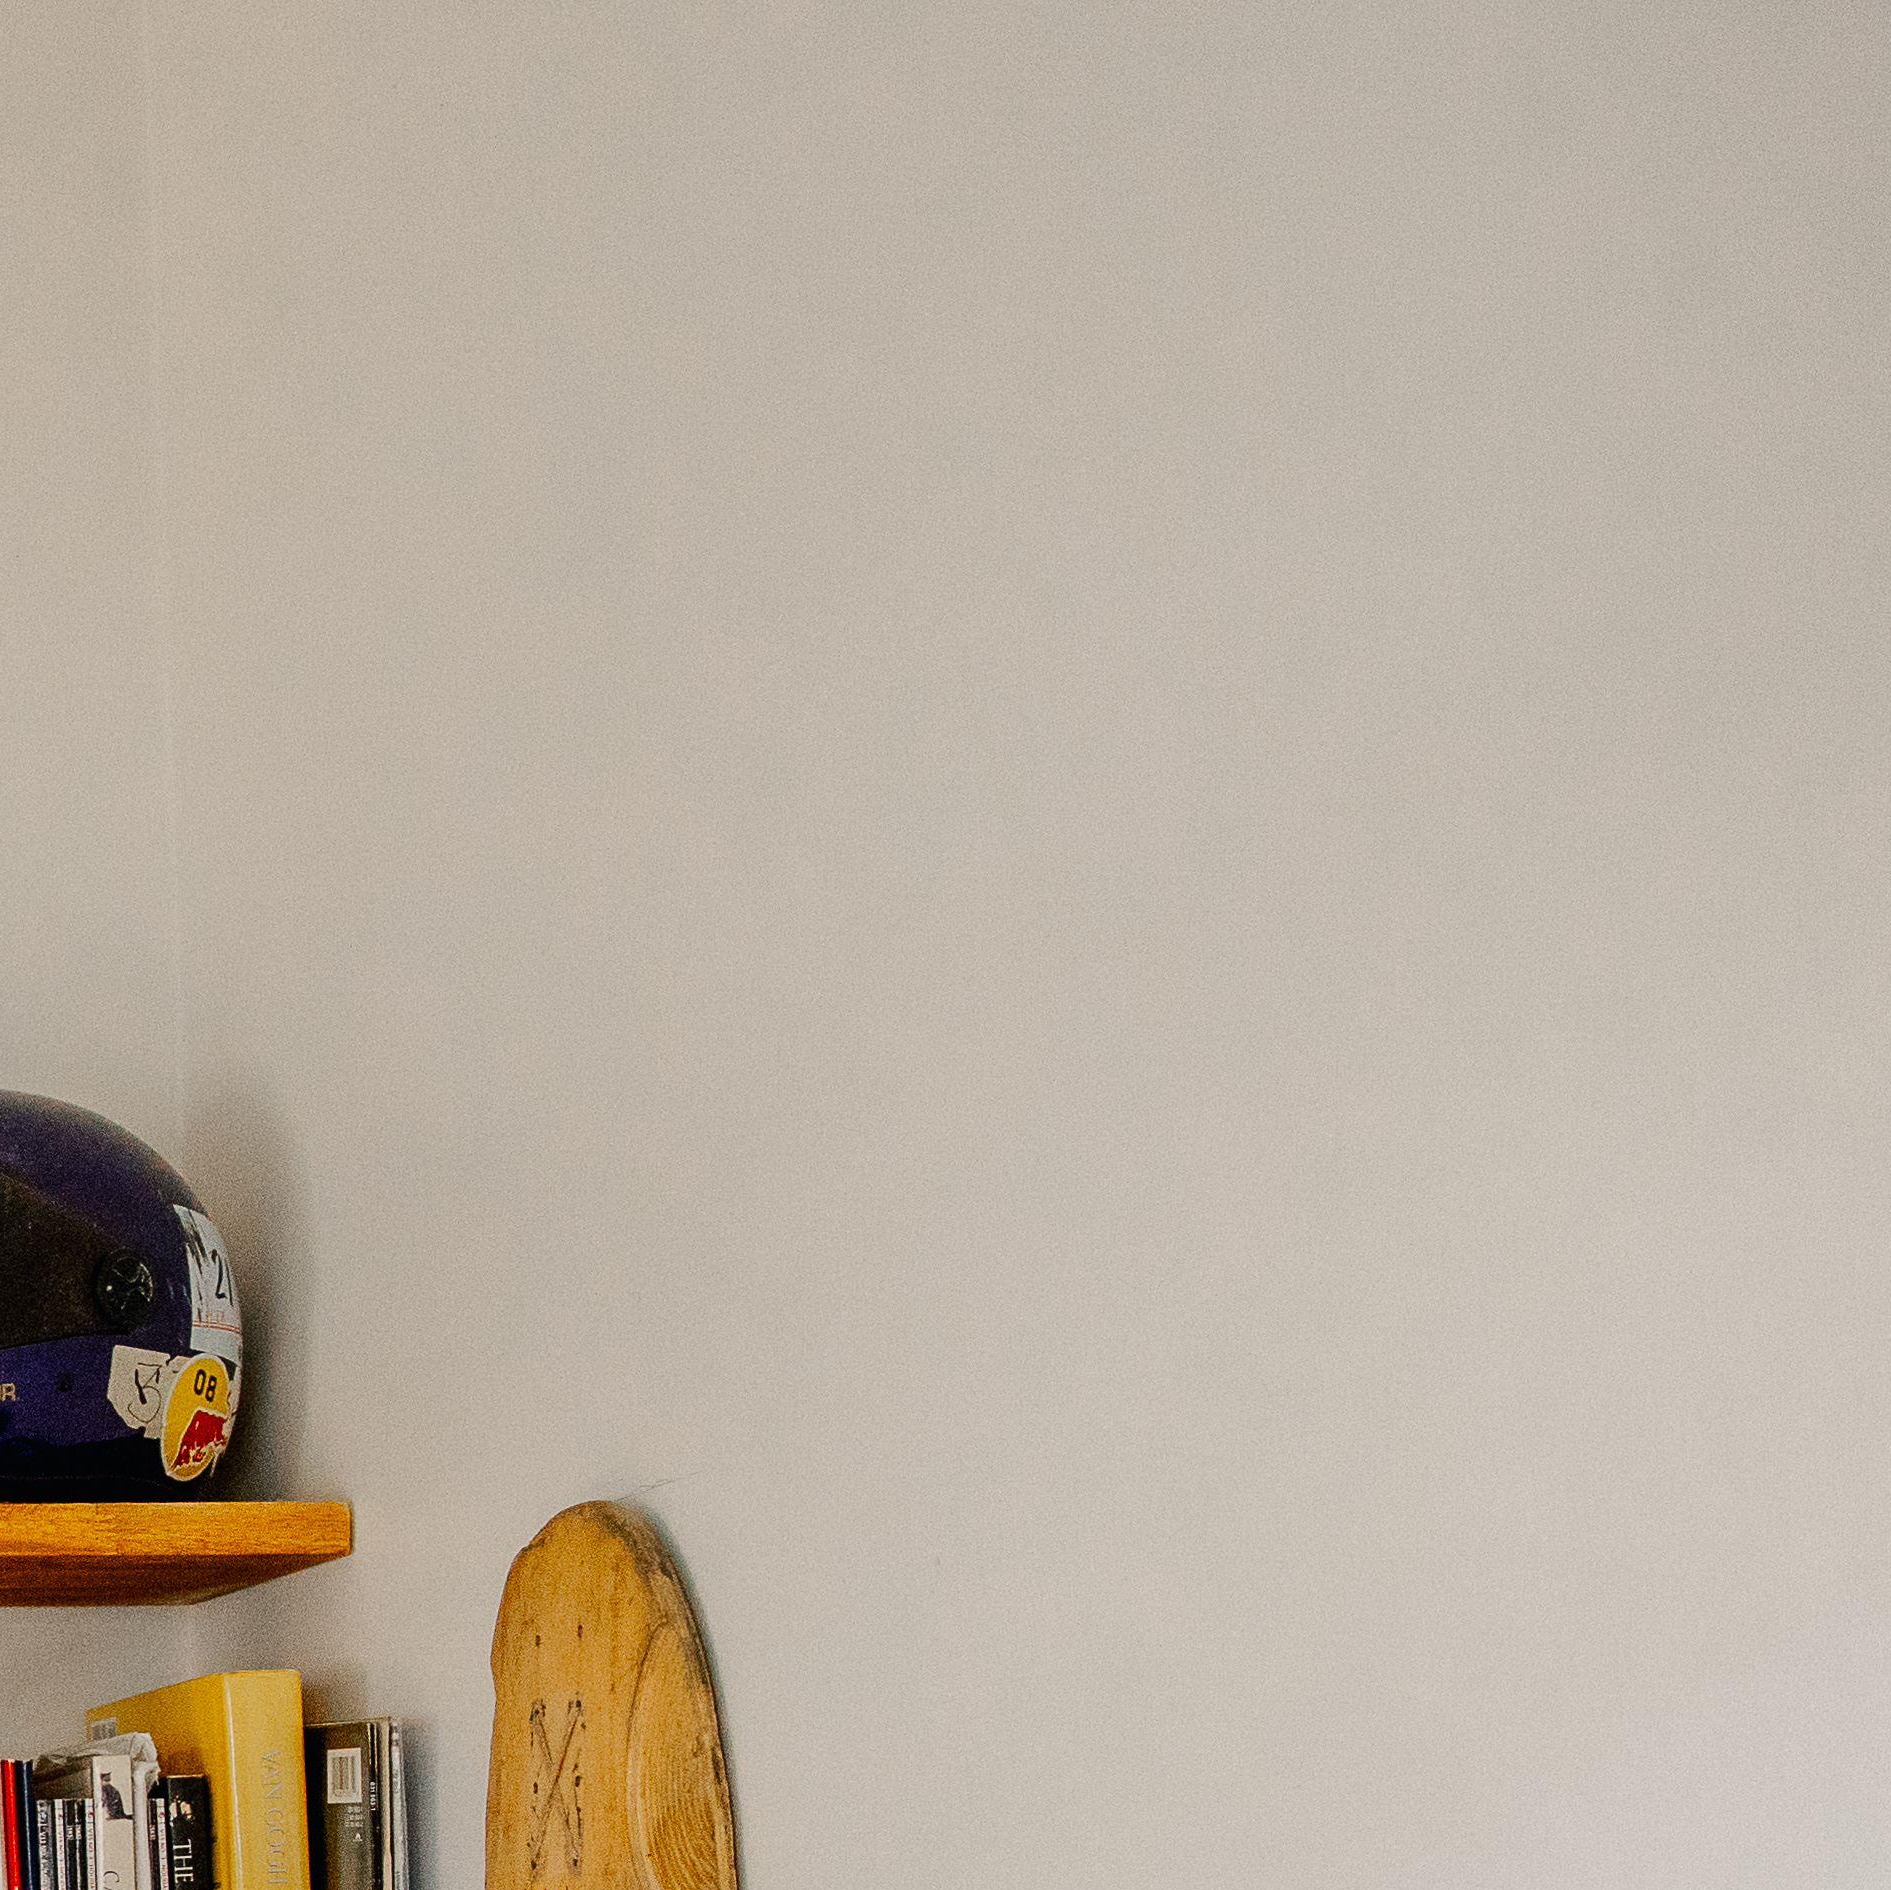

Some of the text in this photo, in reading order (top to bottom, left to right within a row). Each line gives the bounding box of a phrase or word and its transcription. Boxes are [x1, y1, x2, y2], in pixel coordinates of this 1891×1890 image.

[193, 1368, 218, 1403] 08
[261, 1749, 288, 1884] VAN GOGH
[172, 1838, 194, 1883] THE
